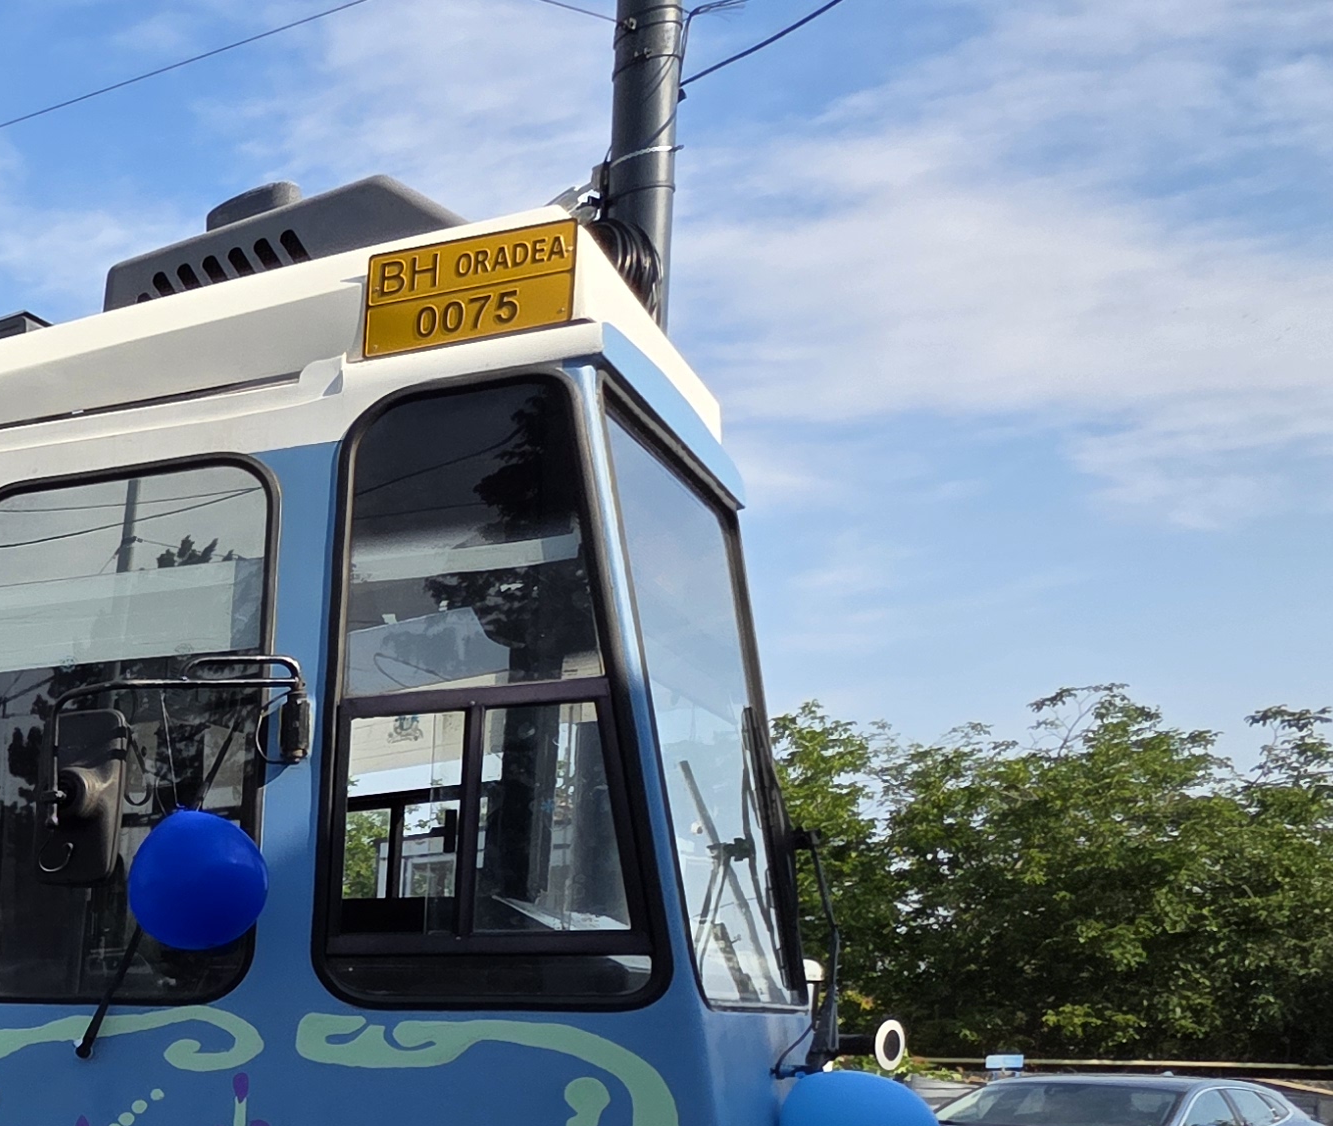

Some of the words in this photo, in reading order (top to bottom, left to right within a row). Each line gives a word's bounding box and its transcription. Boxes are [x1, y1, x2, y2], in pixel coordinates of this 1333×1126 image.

[380, 253, 439, 296] BH
[455, 235, 566, 277] ORADEA
[416, 289, 520, 338] 0075
